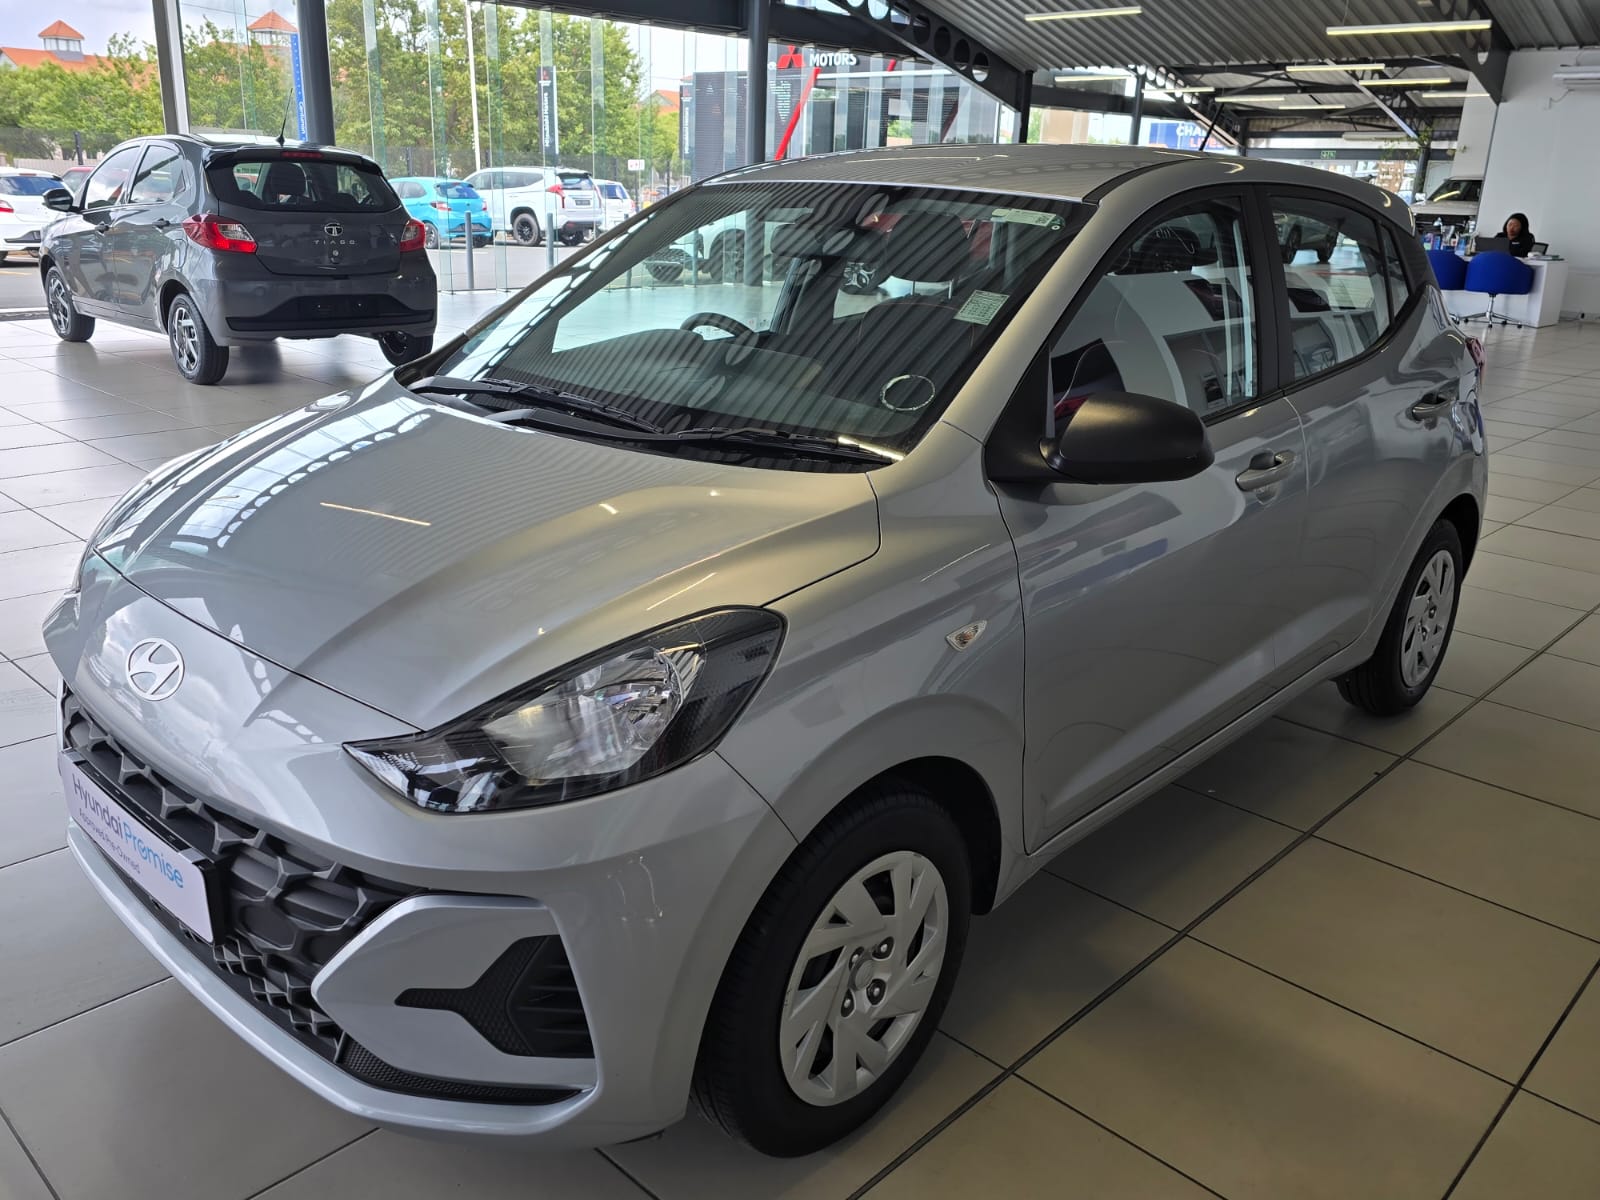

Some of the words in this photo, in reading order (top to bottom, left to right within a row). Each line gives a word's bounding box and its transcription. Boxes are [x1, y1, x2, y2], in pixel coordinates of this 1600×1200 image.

[809, 52, 857, 67] MOTORS
[72, 773, 123, 839] Hyundai
[123, 821, 184, 888] Promise
